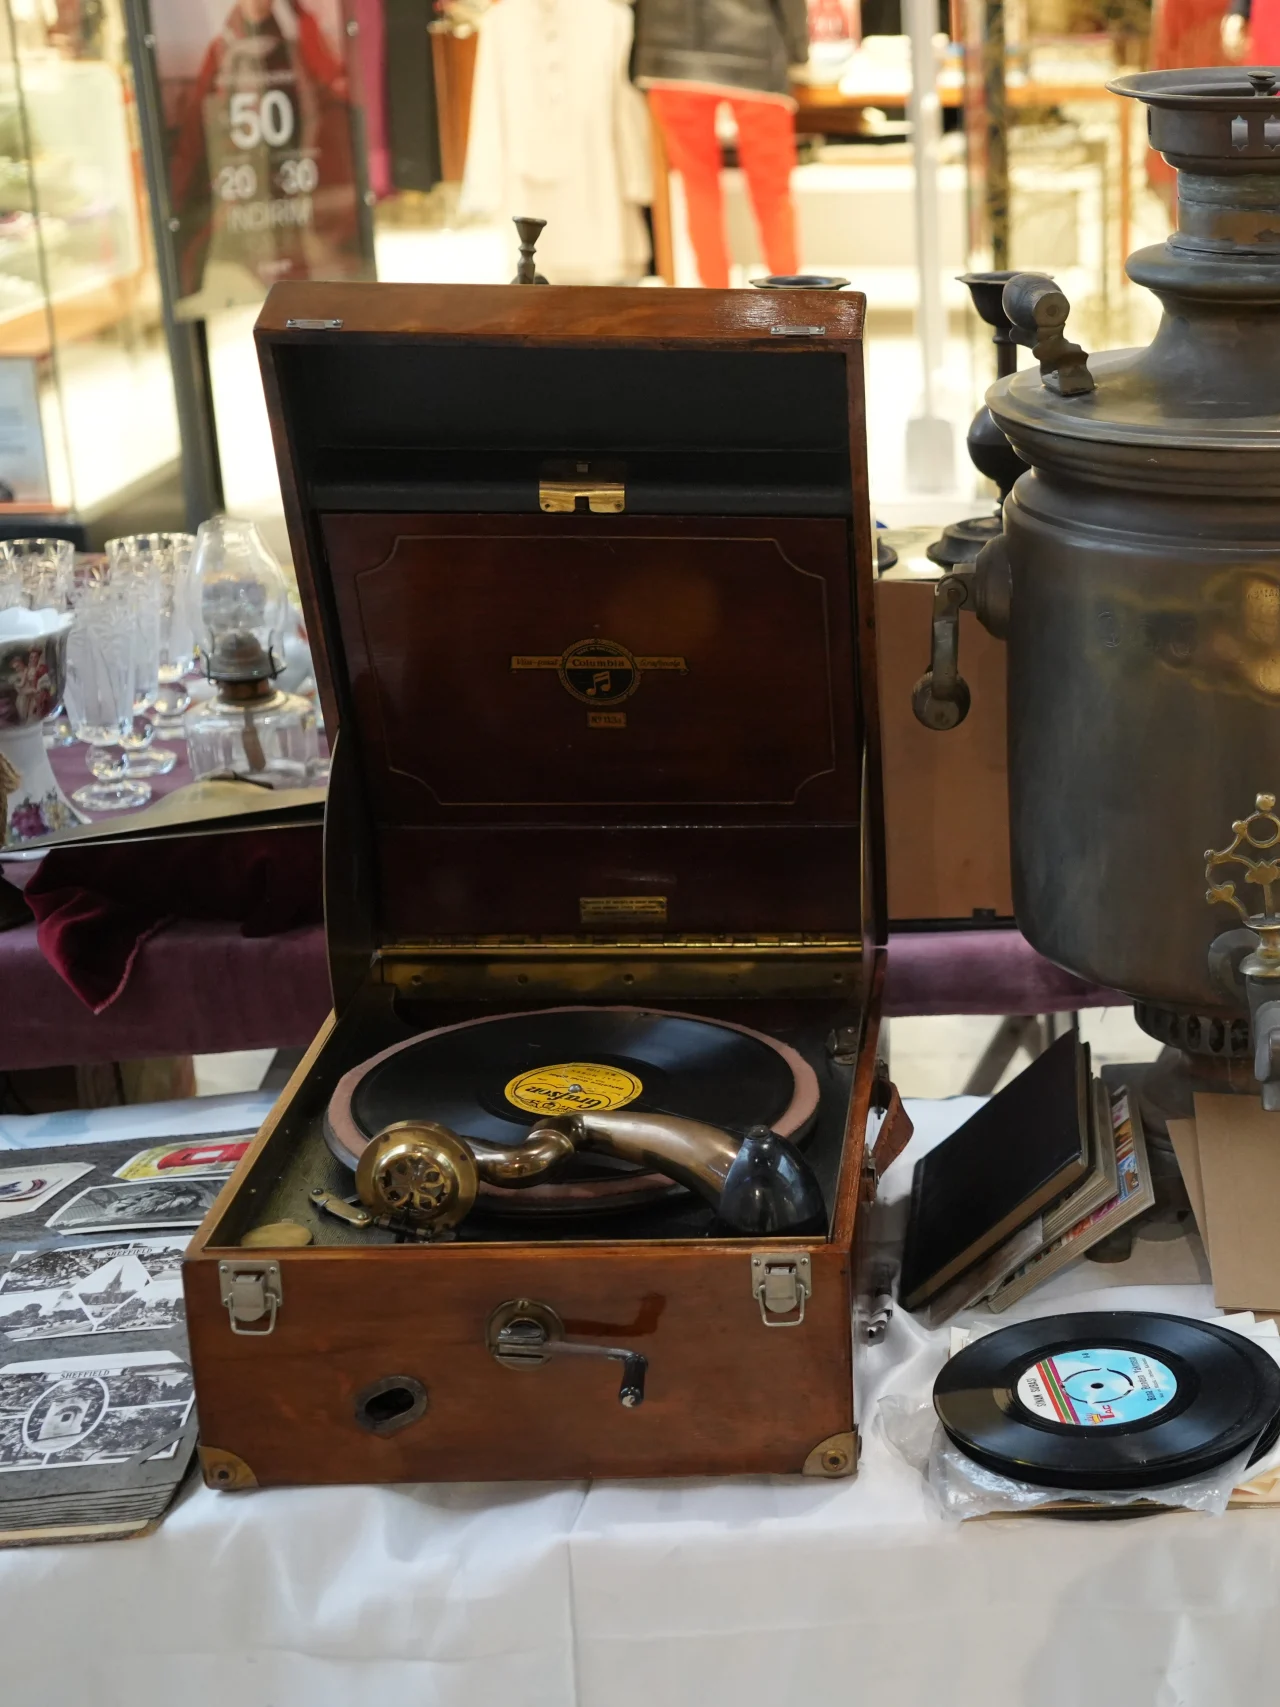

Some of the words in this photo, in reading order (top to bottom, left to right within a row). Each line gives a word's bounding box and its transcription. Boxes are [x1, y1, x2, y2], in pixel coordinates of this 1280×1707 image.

[230, 90, 294, 149] 50
[218, 164, 258, 200] 20
[280, 158, 318, 195] 30
[572, 658, 625, 667] Columbia
[106, 1248, 152, 1257] SHEFFIELD
[60, 1369, 111, 1379] SHEFFIELD
